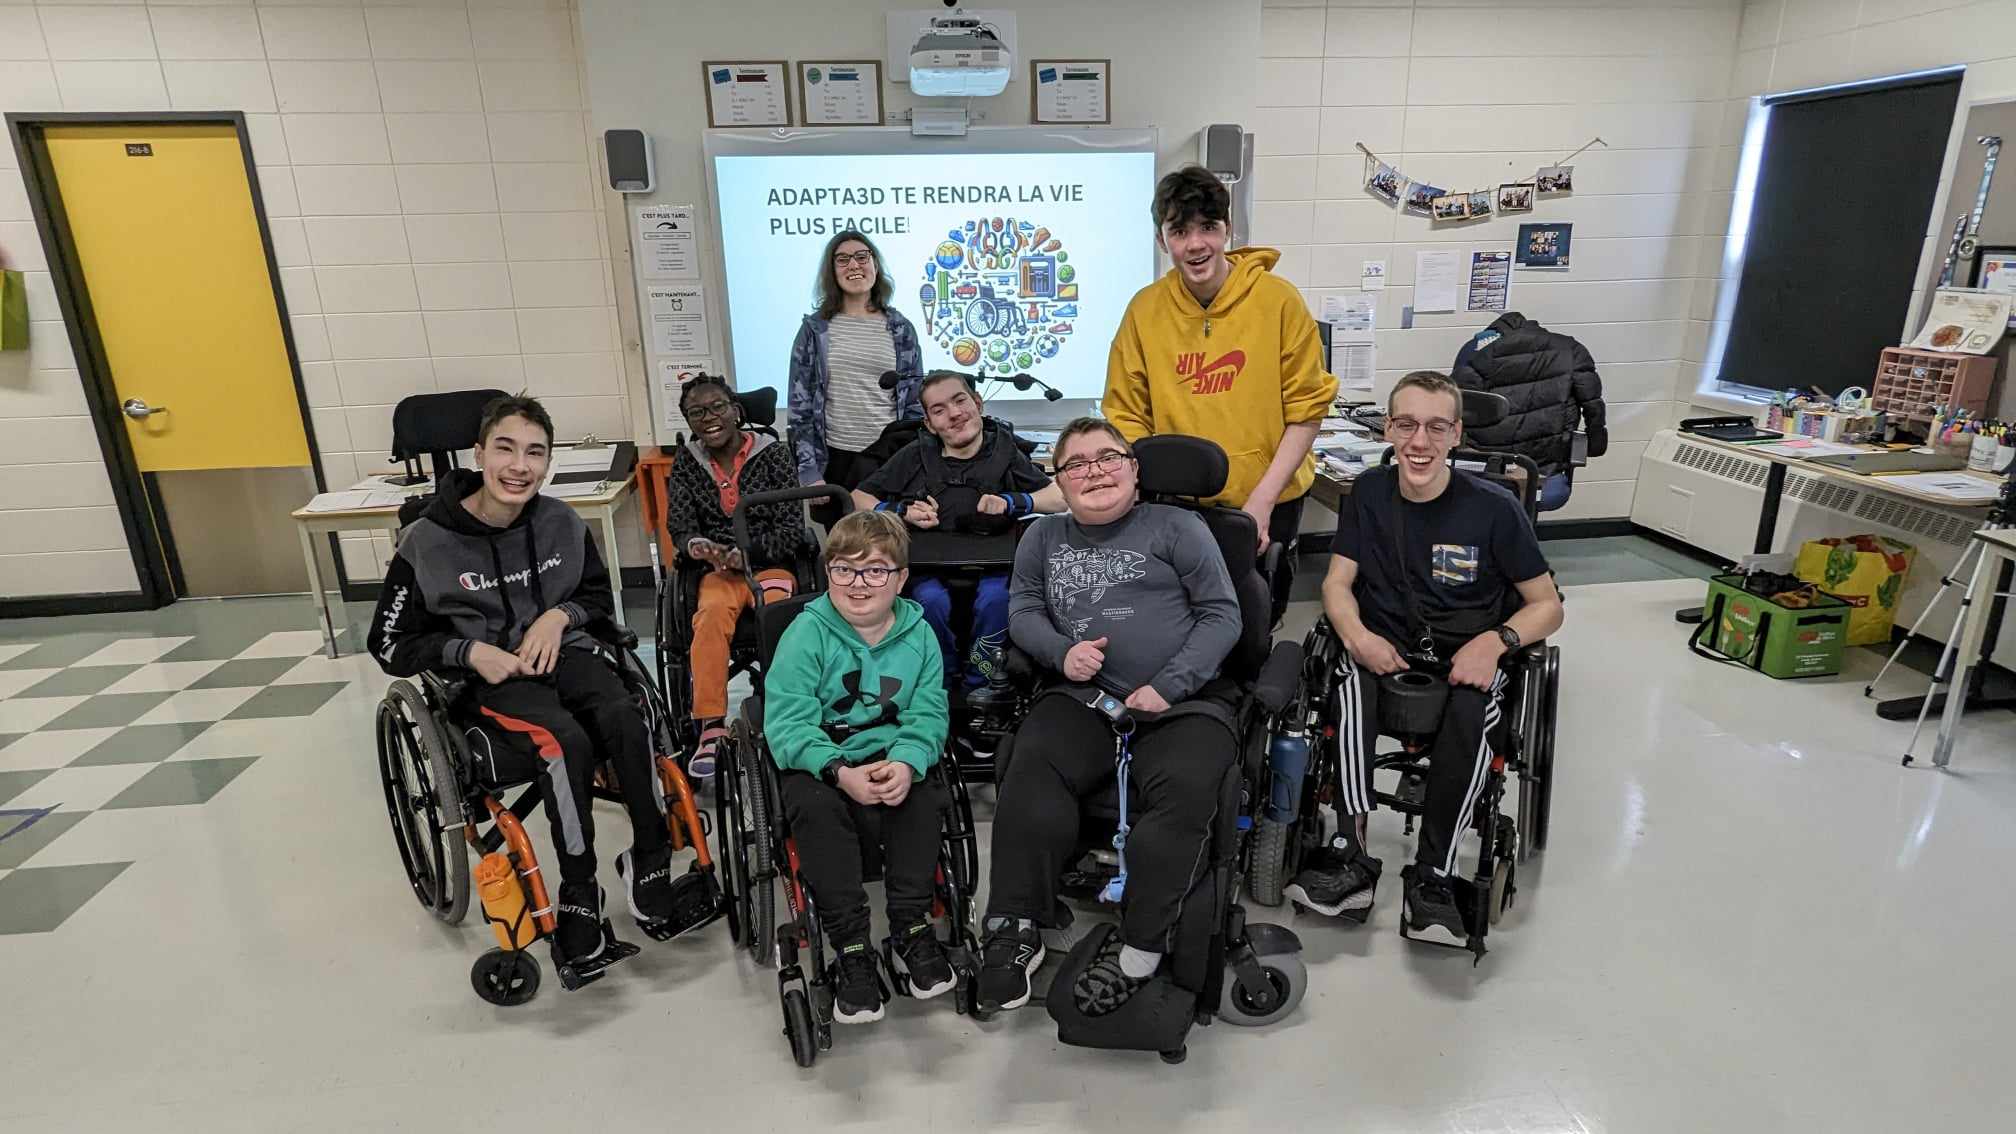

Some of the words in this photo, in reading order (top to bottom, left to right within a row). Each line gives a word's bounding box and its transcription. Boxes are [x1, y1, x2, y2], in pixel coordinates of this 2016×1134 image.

[767, 187, 885, 206] ADAPTA3D
[891, 187, 917, 204] TE
[923, 185, 1012, 204] RENDRA
[1018, 185, 1044, 203] LA
[1050, 184, 1084, 202] VIE
[770, 217, 826, 235] PLUS
[1192, 371, 1235, 394] NIKE
[459, 556, 562, 591] Champion
